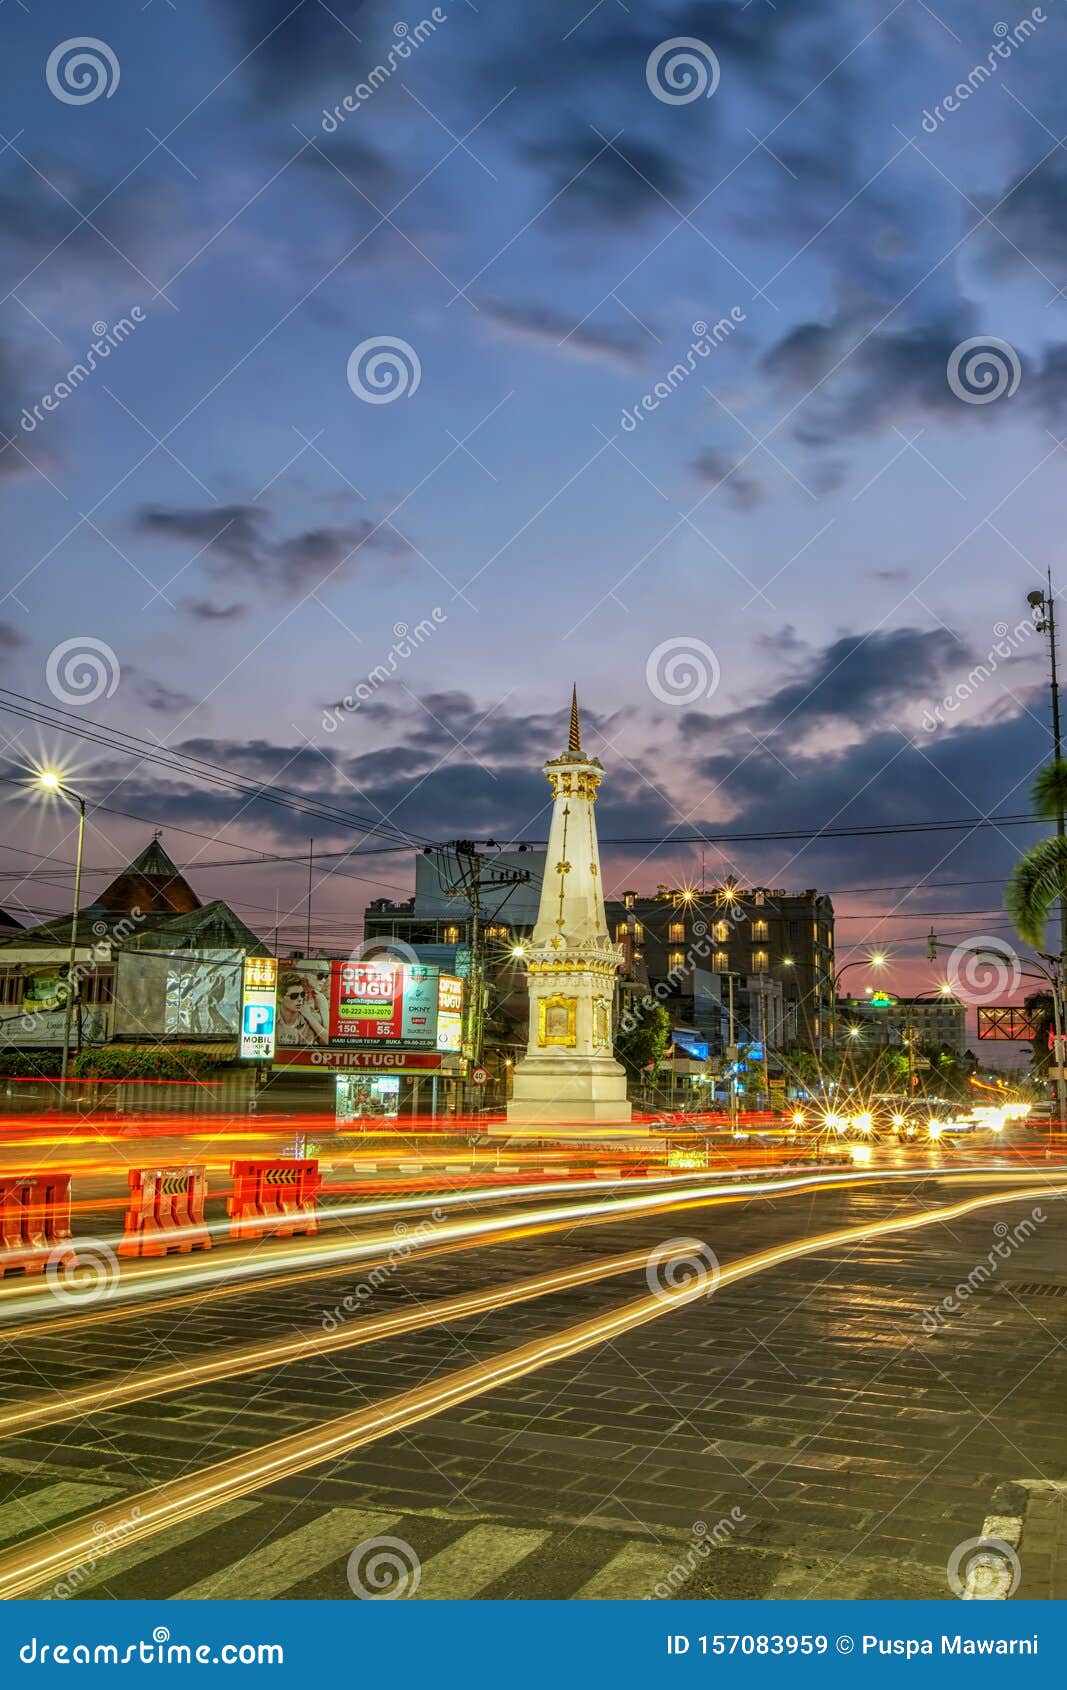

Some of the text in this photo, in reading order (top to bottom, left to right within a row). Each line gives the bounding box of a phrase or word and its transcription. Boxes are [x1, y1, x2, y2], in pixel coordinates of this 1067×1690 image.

[342, 967, 393, 981] OPTIK
[342, 981, 393, 996] TUGU
[439, 993, 461, 1010] TUGU
[249, 1007, 269, 1033] P
[243, 1036, 272, 1044] MOBIL
[310, 1052, 406, 1066] OPTIK TUGU
